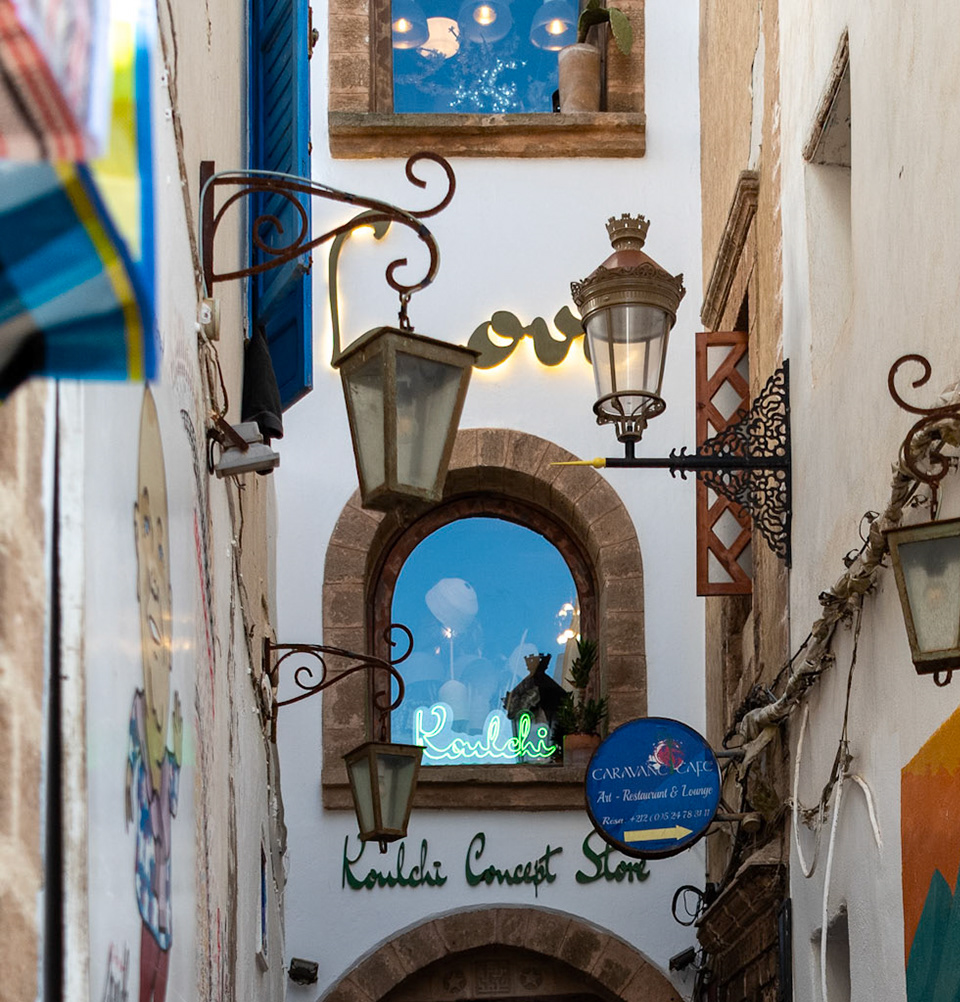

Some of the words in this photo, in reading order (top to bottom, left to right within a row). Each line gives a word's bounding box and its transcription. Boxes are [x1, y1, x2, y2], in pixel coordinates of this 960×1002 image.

[415, 705, 557, 760] Koulchi
[596, 790, 612, 804] Art
[622, 788, 668, 802] Restaurant
[670, 785, 678, 798] &
[681, 784, 713, 799] Lounge
[342, 834, 448, 890] Koulchi
[465, 832, 563, 898] Concept
[575, 829, 651, 885] Store
